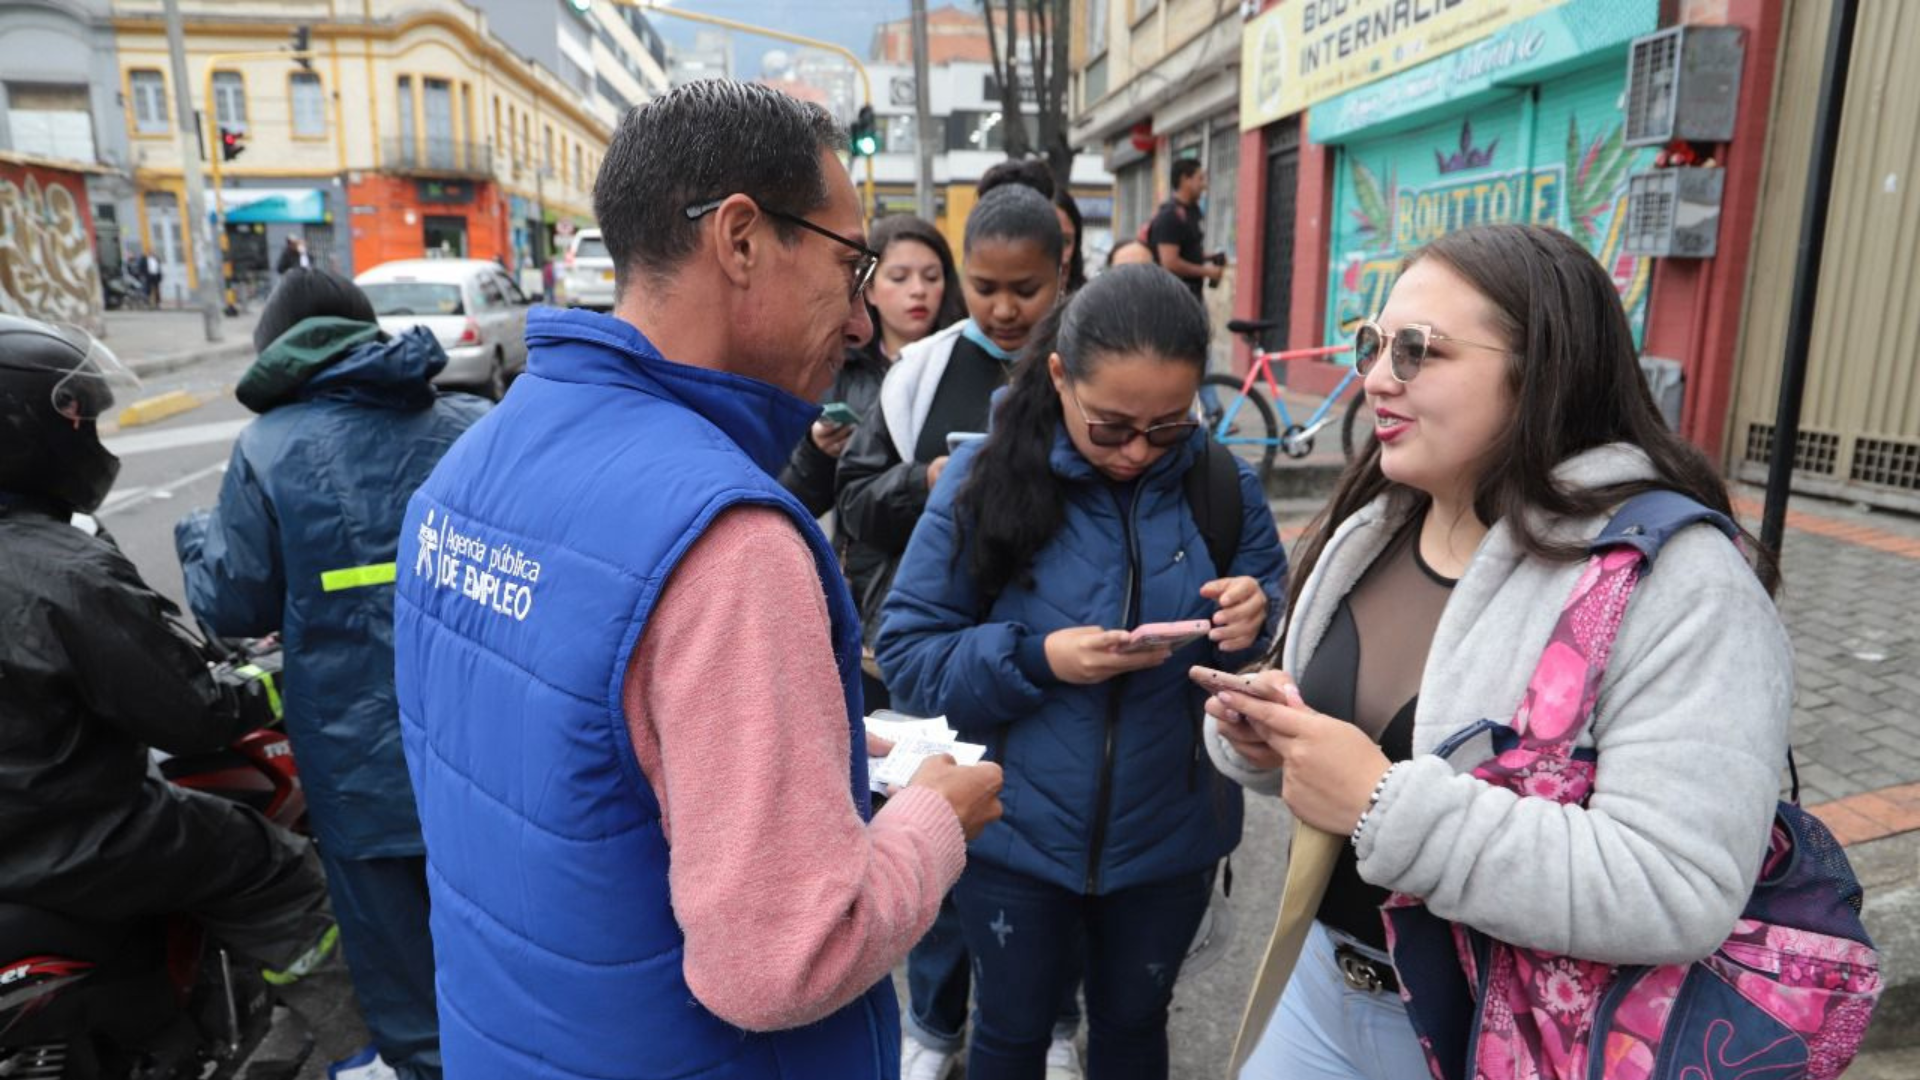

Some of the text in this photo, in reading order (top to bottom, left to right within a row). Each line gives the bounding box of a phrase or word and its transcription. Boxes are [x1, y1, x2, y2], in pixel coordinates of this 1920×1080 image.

[446, 526, 541, 582] Agencia pública
[442, 554, 532, 621] DE EMPLEO
